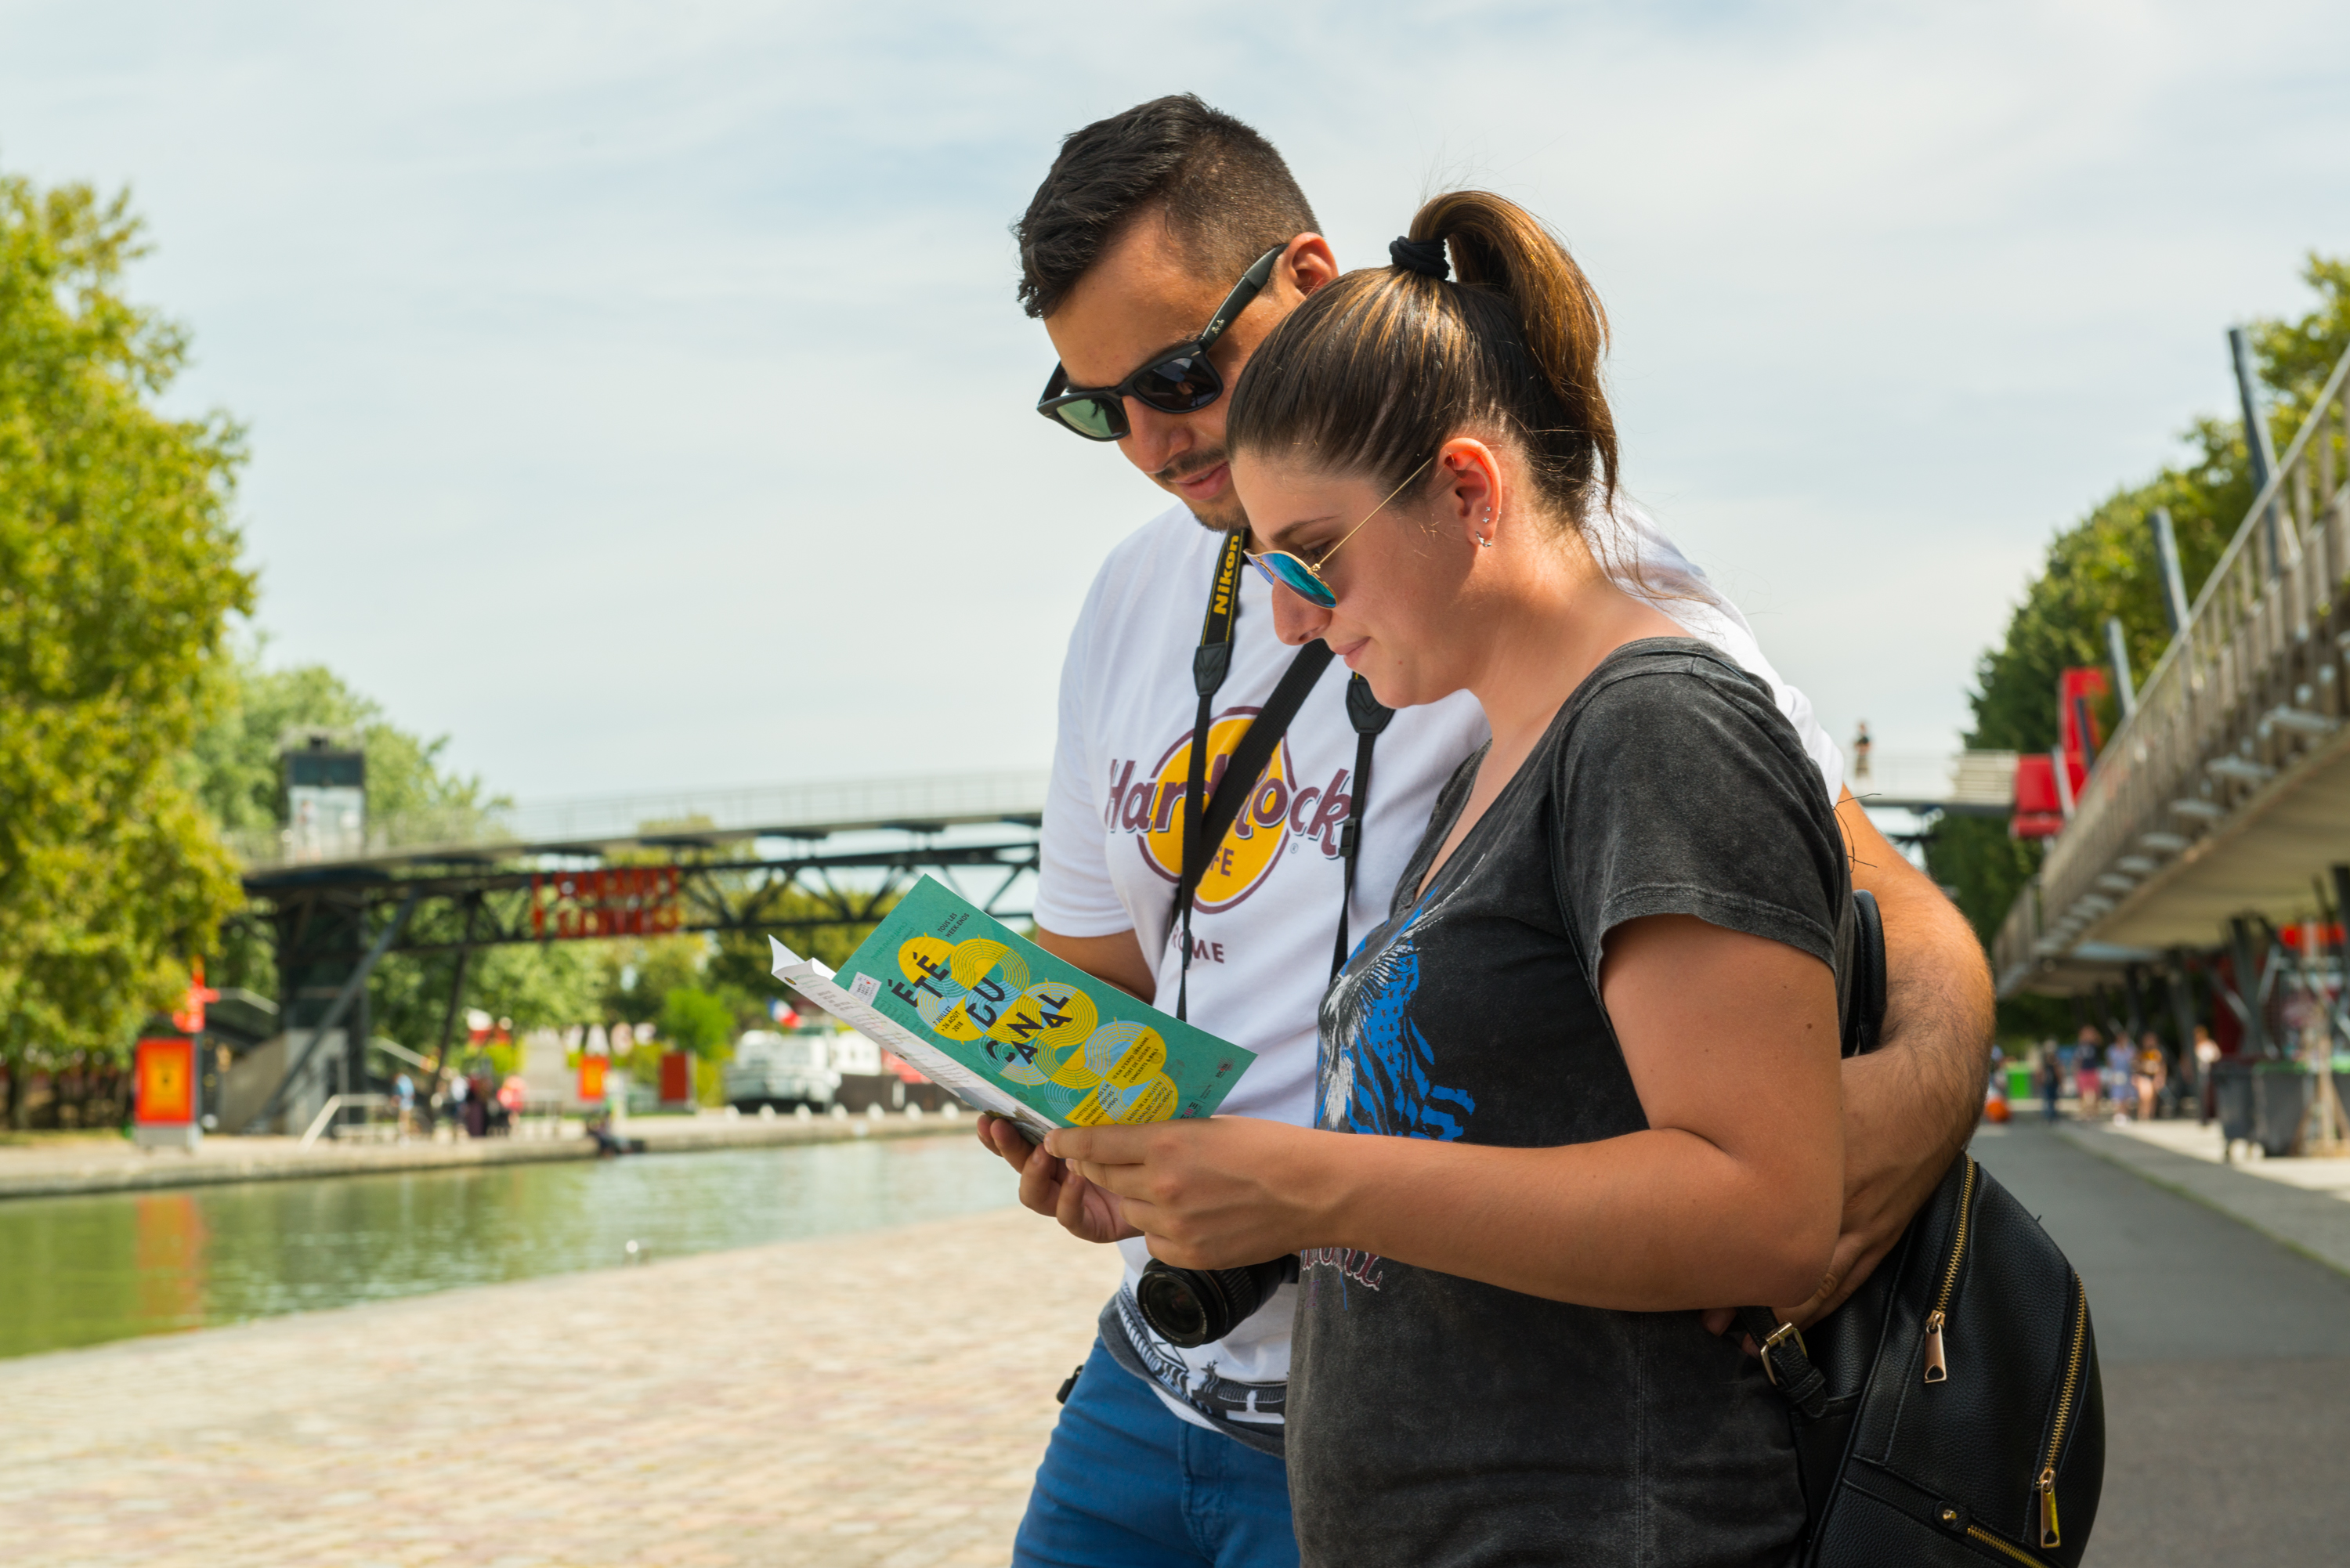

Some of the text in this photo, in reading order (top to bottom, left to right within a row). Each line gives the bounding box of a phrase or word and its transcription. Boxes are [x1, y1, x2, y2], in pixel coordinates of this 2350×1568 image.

[1213, 535, 1239, 615] Nikon
[937, 912, 957, 933] TOUS LES
[945, 912, 970, 938] WEEK-ENDS
[888, 952, 949, 1008] ÉTÉ
[936, 1006, 953, 1023] JUILLET
[948, 1010, 961, 1024] AOÛT
[965, 977, 1005, 1028] DU
[952, 1021, 964, 1032] 2018
[985, 993, 1073, 1065] CANAL
[1132, 1037, 1149, 1055] URBAINE
[1123, 1068, 1133, 1078] PORT
[1137, 1046, 1152, 1062] LOISIRS
[1129, 1062, 1148, 1083] CONCERTS
[1148, 1048, 1159, 1059] BALS
